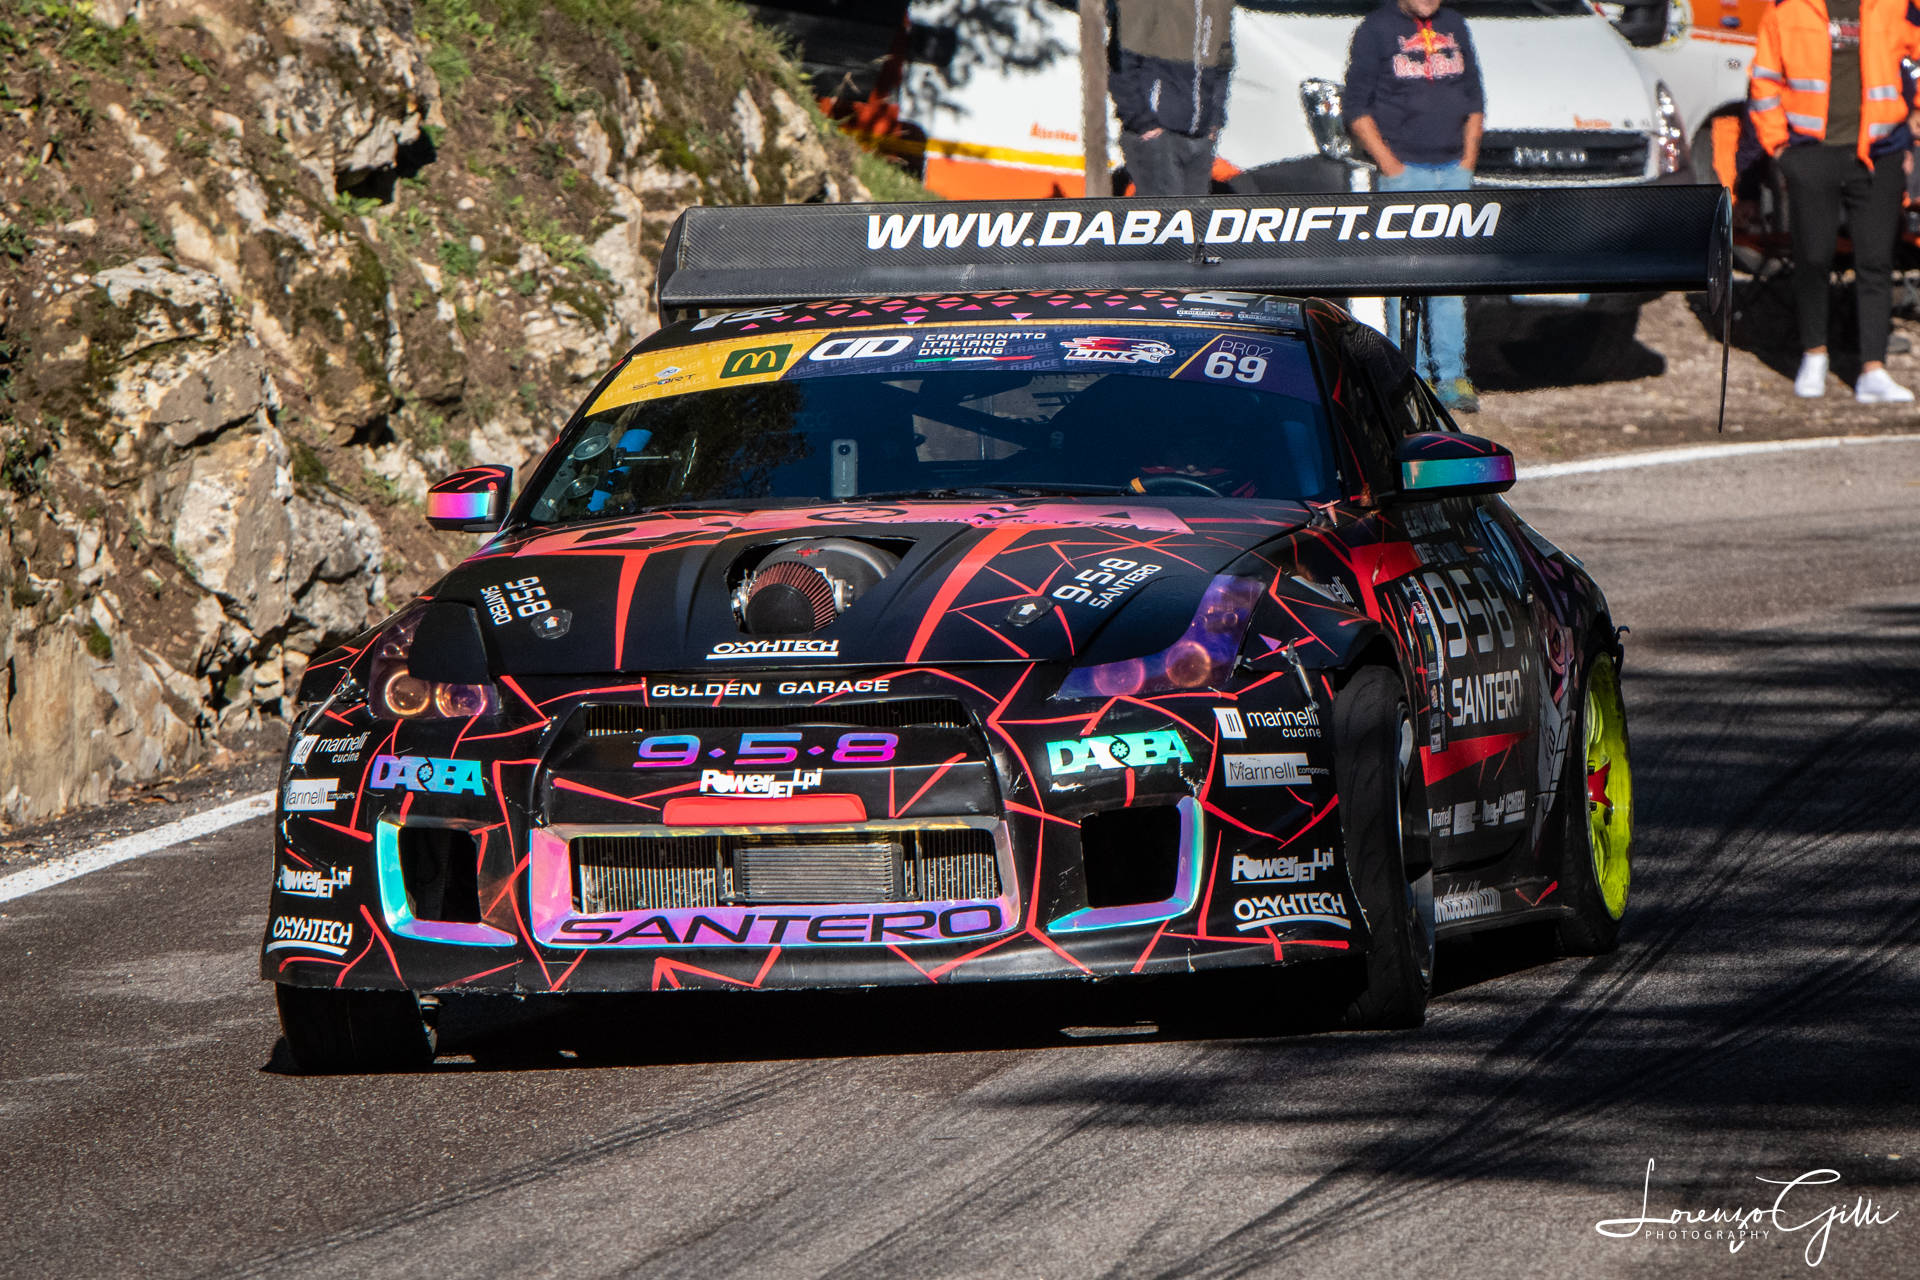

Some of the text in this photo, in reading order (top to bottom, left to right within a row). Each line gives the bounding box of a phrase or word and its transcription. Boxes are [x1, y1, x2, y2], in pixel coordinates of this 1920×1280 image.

[921, 340, 1007, 348] ITALIANO
[924, 332, 1047, 341] CAMPIONATO
[917, 347, 1004, 356] DRIFTING
[1068, 349, 1138, 361] LINK
[1218, 340, 1274, 361] PRO2
[1203, 351, 1268, 384] 69
[1088, 564, 1163, 609] SANTERO
[480, 585, 513, 626] SANTERO
[712, 639, 839, 654] OXYHTECH
[651, 679, 891, 698] GOLDEN GARAGE
[1451, 669, 1522, 728] SANTERO
[1246, 706, 1320, 727] marinelli
[1282, 726, 1321, 738] cucine
[331, 751, 361, 764] cucine
[1228, 760, 1297, 781] Marinelli
[1233, 892, 1347, 921] OXYHTECH
[272, 915, 354, 946] OXYHTECH
[551, 904, 1002, 945] SANTERO
